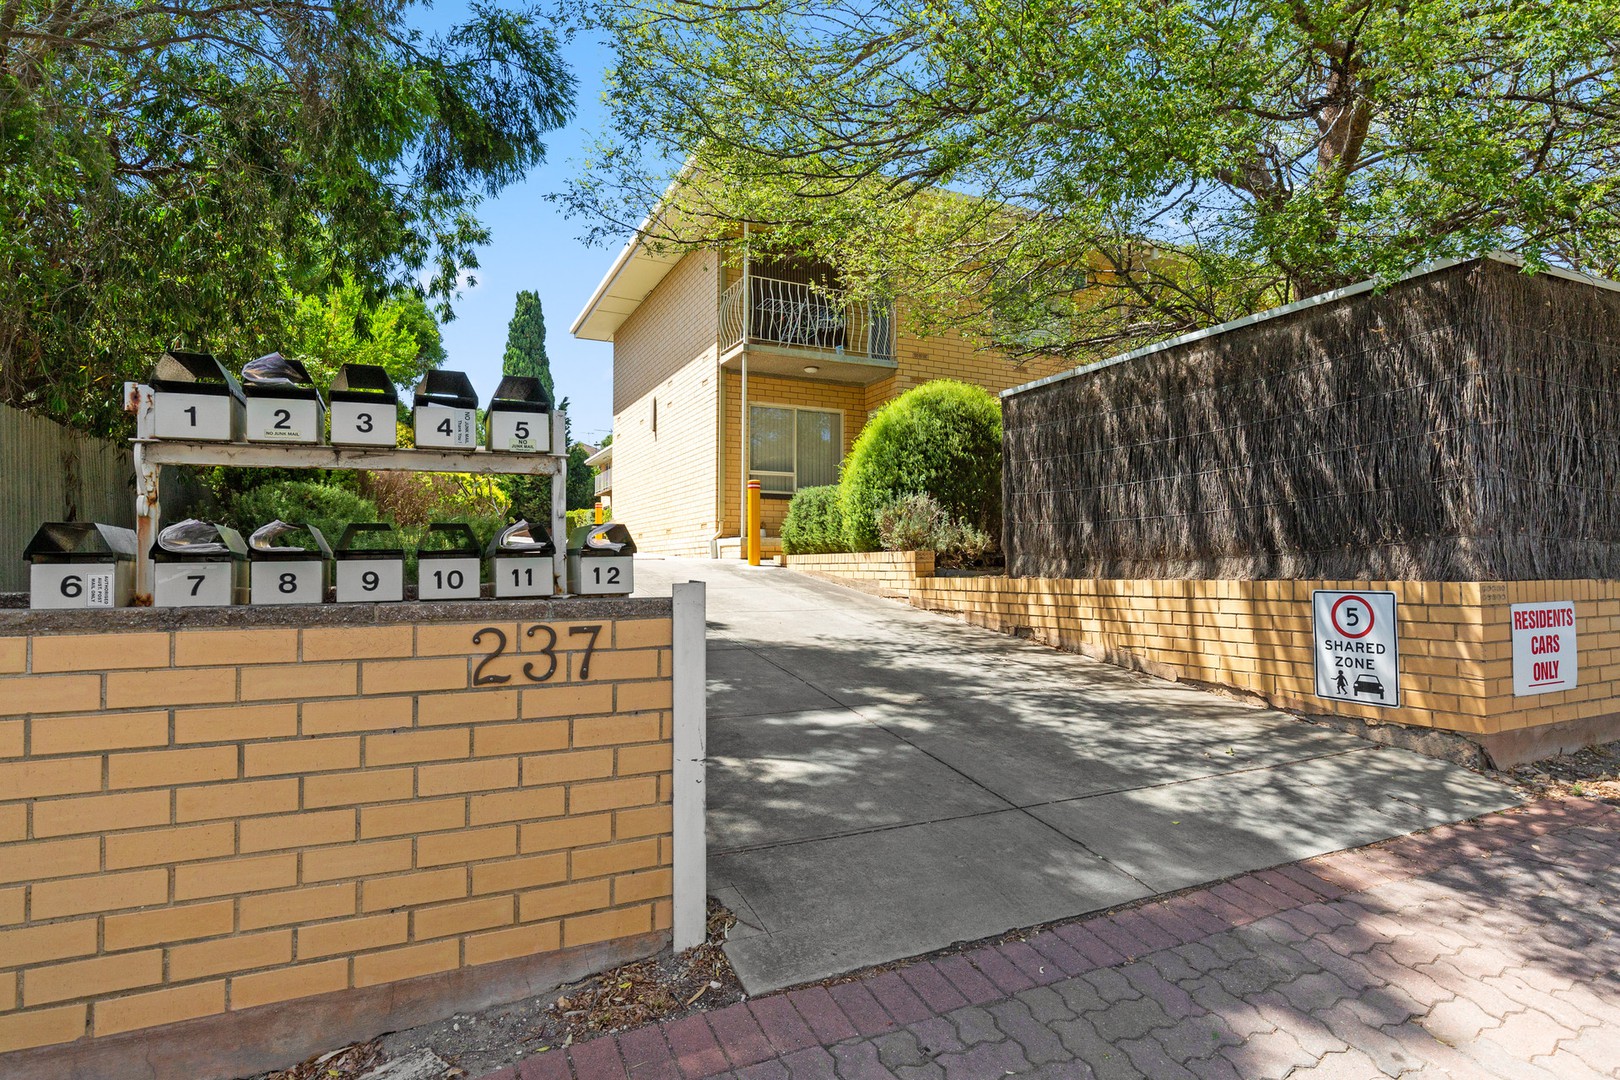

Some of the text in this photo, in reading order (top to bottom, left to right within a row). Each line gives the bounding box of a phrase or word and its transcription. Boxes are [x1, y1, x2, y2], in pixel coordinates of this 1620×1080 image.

[183, 406, 197, 427] 1
[273, 409, 291, 429] 2
[356, 413, 373, 433] 3
[464, 411, 471, 420] NO
[437, 418, 453, 437] 4
[514, 421, 529, 439] 5
[187, 574, 206, 597] 7
[278, 573, 298, 594] 8
[361, 571, 380, 592] 9
[433, 570, 464, 590] 10
[511, 568, 533, 587] 11
[593, 566, 620, 585] 12
[60, 575, 83, 598] 6
[1346, 607, 1359, 627] 5
[1513, 607, 1574, 630] RESIDENTS
[1325, 639, 1386, 655] SHARED
[1531, 634, 1560, 655] CARS
[472, 624, 603, 686] 237
[1335, 656, 1375, 670] ZONE
[1533, 660, 1560, 682] ONLY
